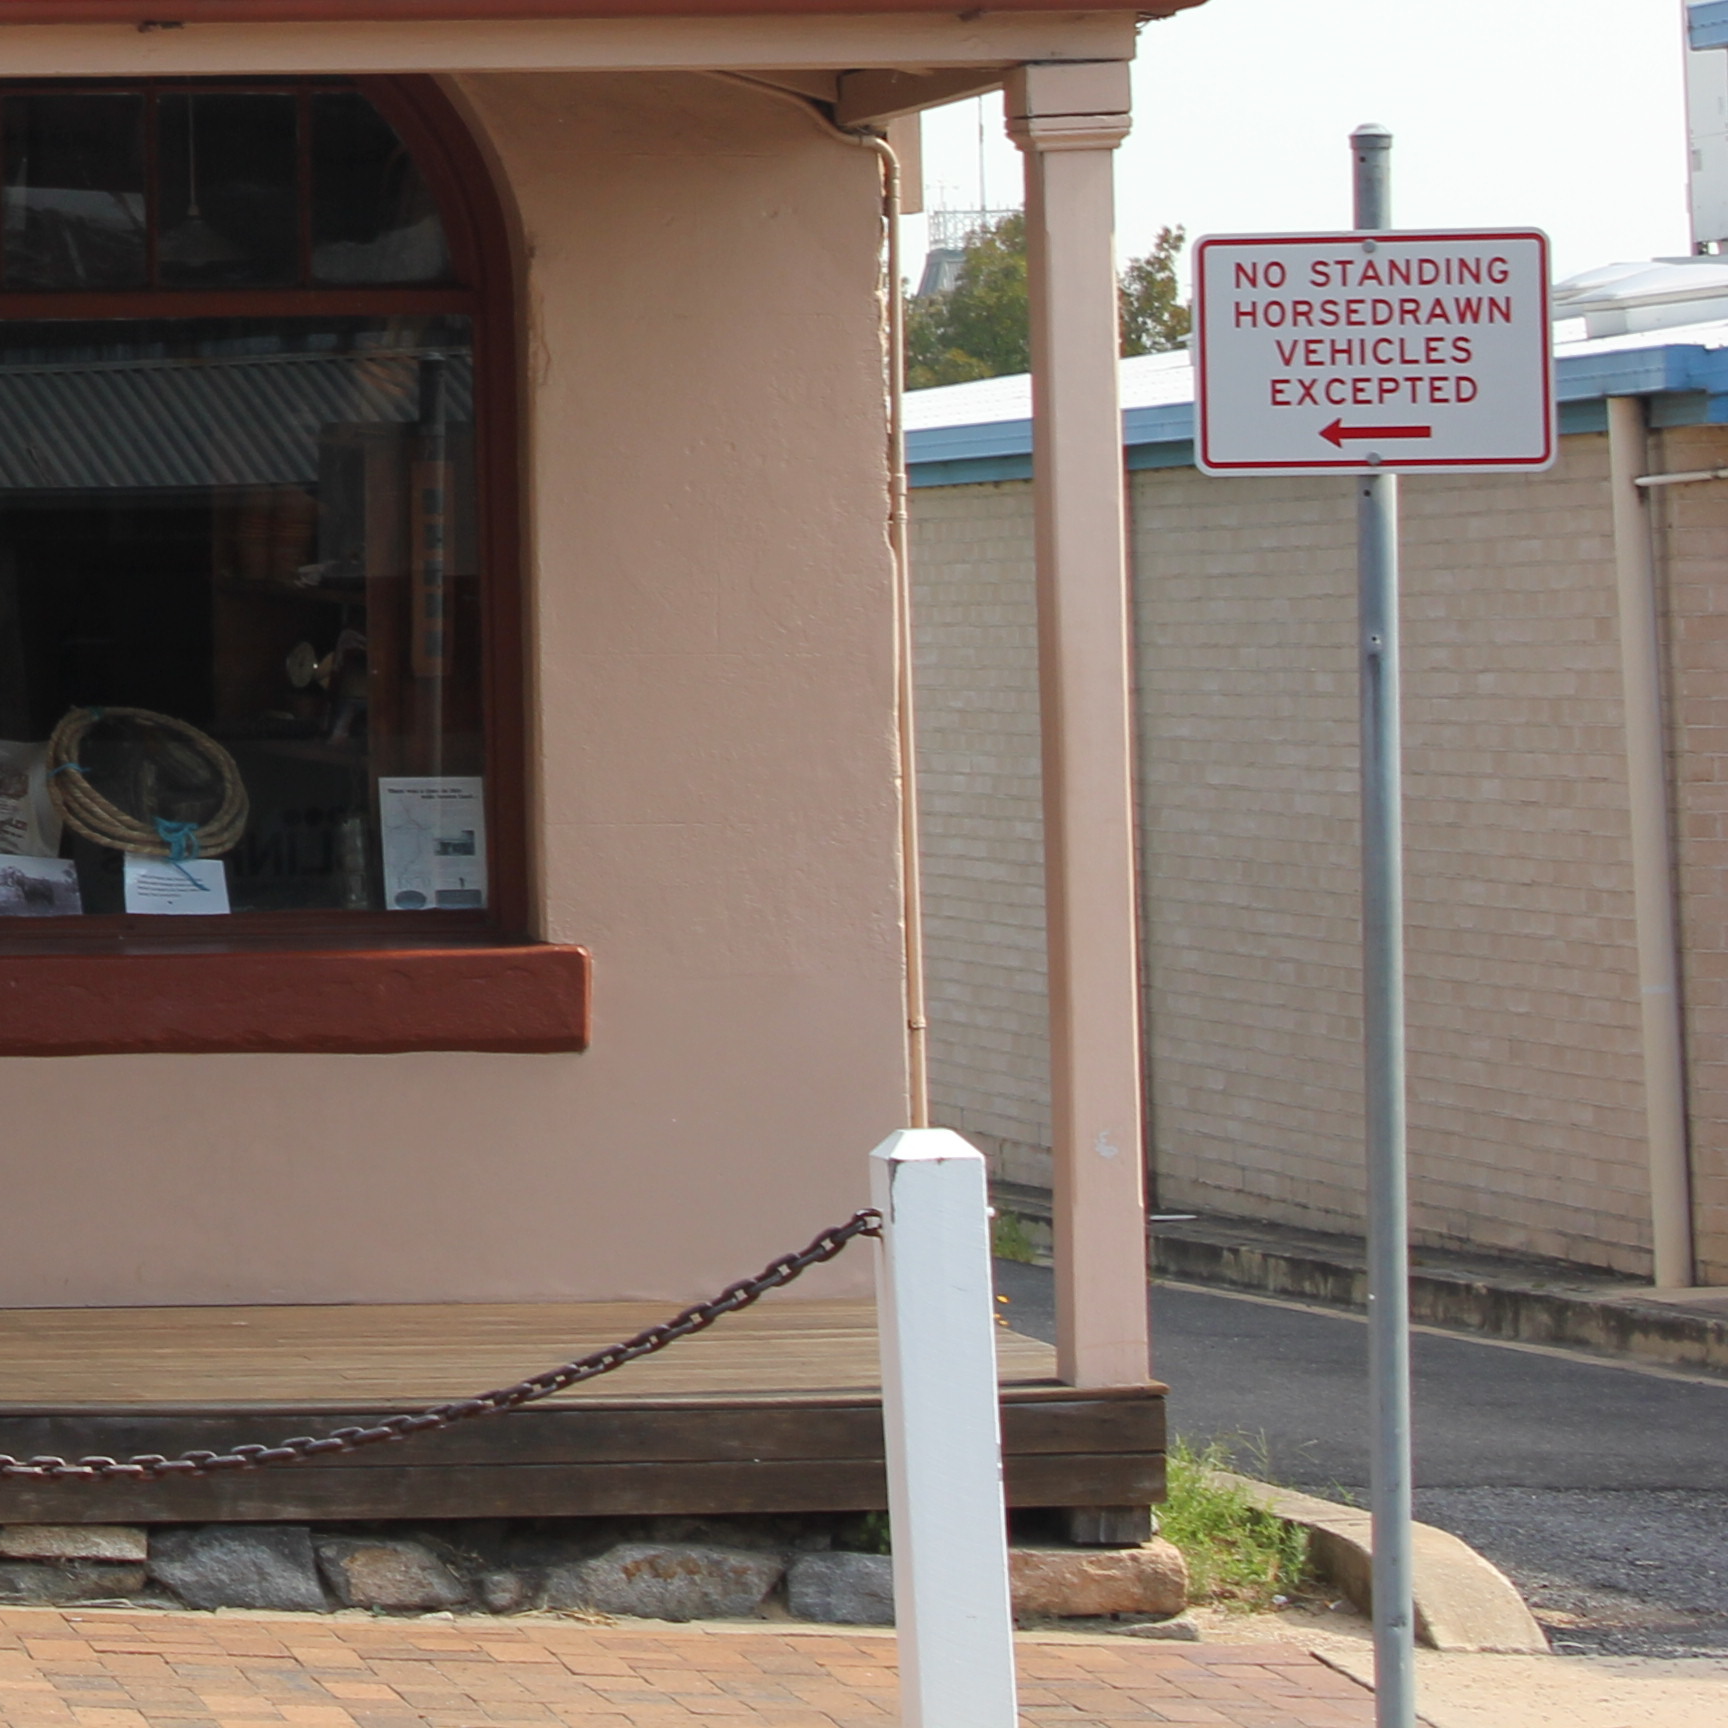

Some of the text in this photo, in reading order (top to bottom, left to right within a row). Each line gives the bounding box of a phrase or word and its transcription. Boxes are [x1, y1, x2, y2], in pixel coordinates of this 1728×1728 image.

[1234, 256, 1511, 289] NO STANDING
[1234, 296, 1512, 328] HORSEDRAWN
[1275, 336, 1473, 367] VEHICLES
[1270, 376, 1479, 407] EXCEPTED
